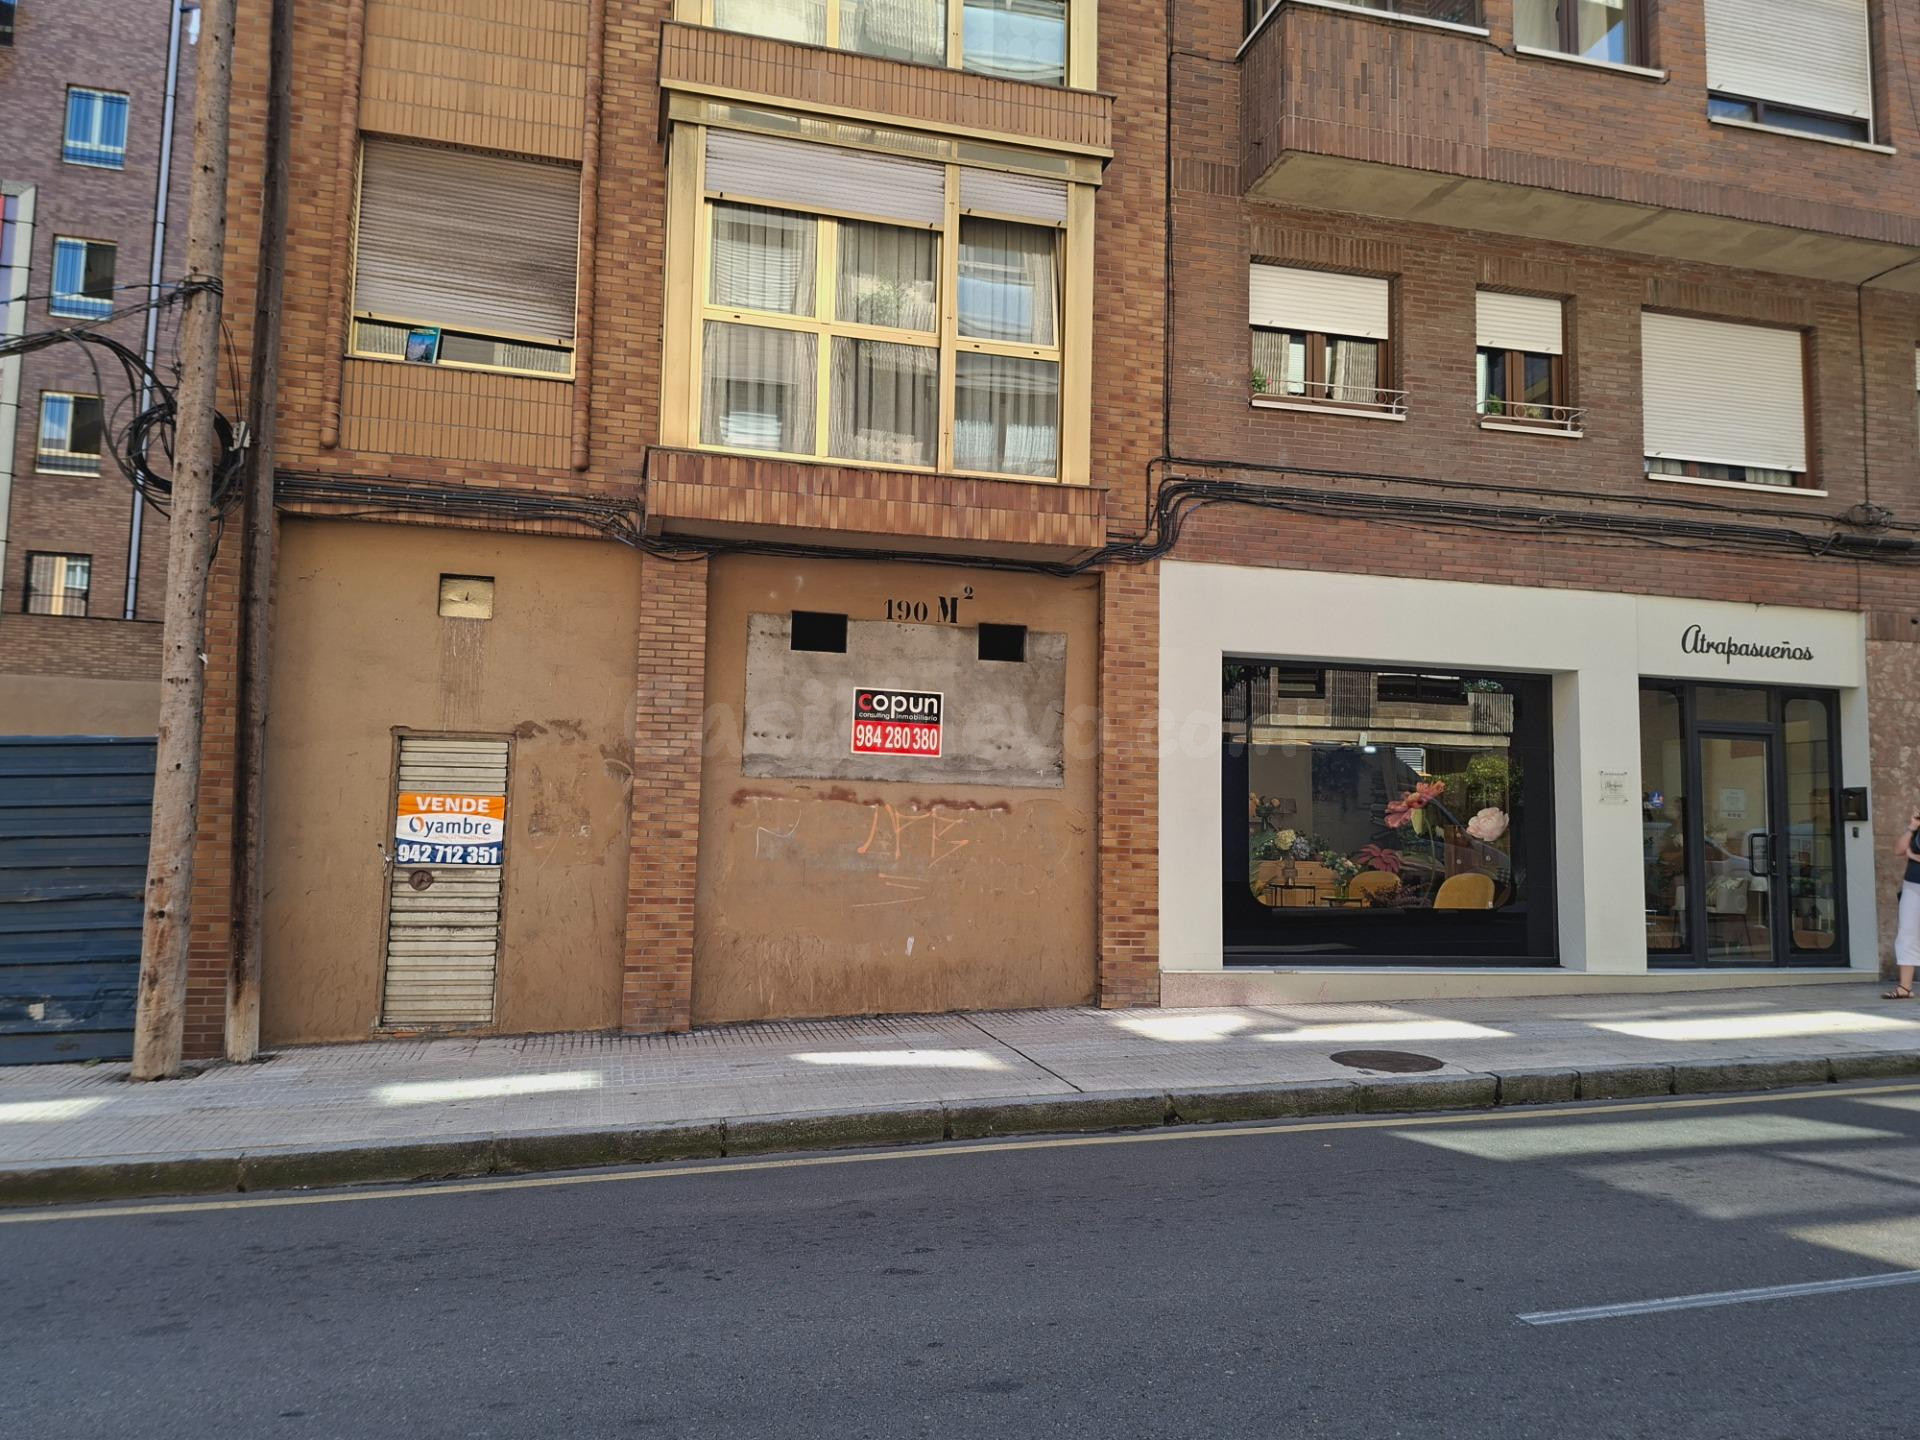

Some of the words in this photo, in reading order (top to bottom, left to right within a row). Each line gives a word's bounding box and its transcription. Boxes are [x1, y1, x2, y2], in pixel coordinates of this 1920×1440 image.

[883, 599, 929, 622] 190
[1681, 624, 1814, 665] Atrapasueños
[858, 693, 938, 719] copun
[858, 711, 890, 720] consulting
[856, 724, 881, 748] 984
[885, 726, 911, 749] 280
[913, 727, 938, 750] 380
[416, 796, 490, 813] VENDE
[409, 816, 491, 838] Oyambre
[397, 844, 432, 862] 942
[435, 845, 463, 863] 712
[466, 846, 498, 864] 351
